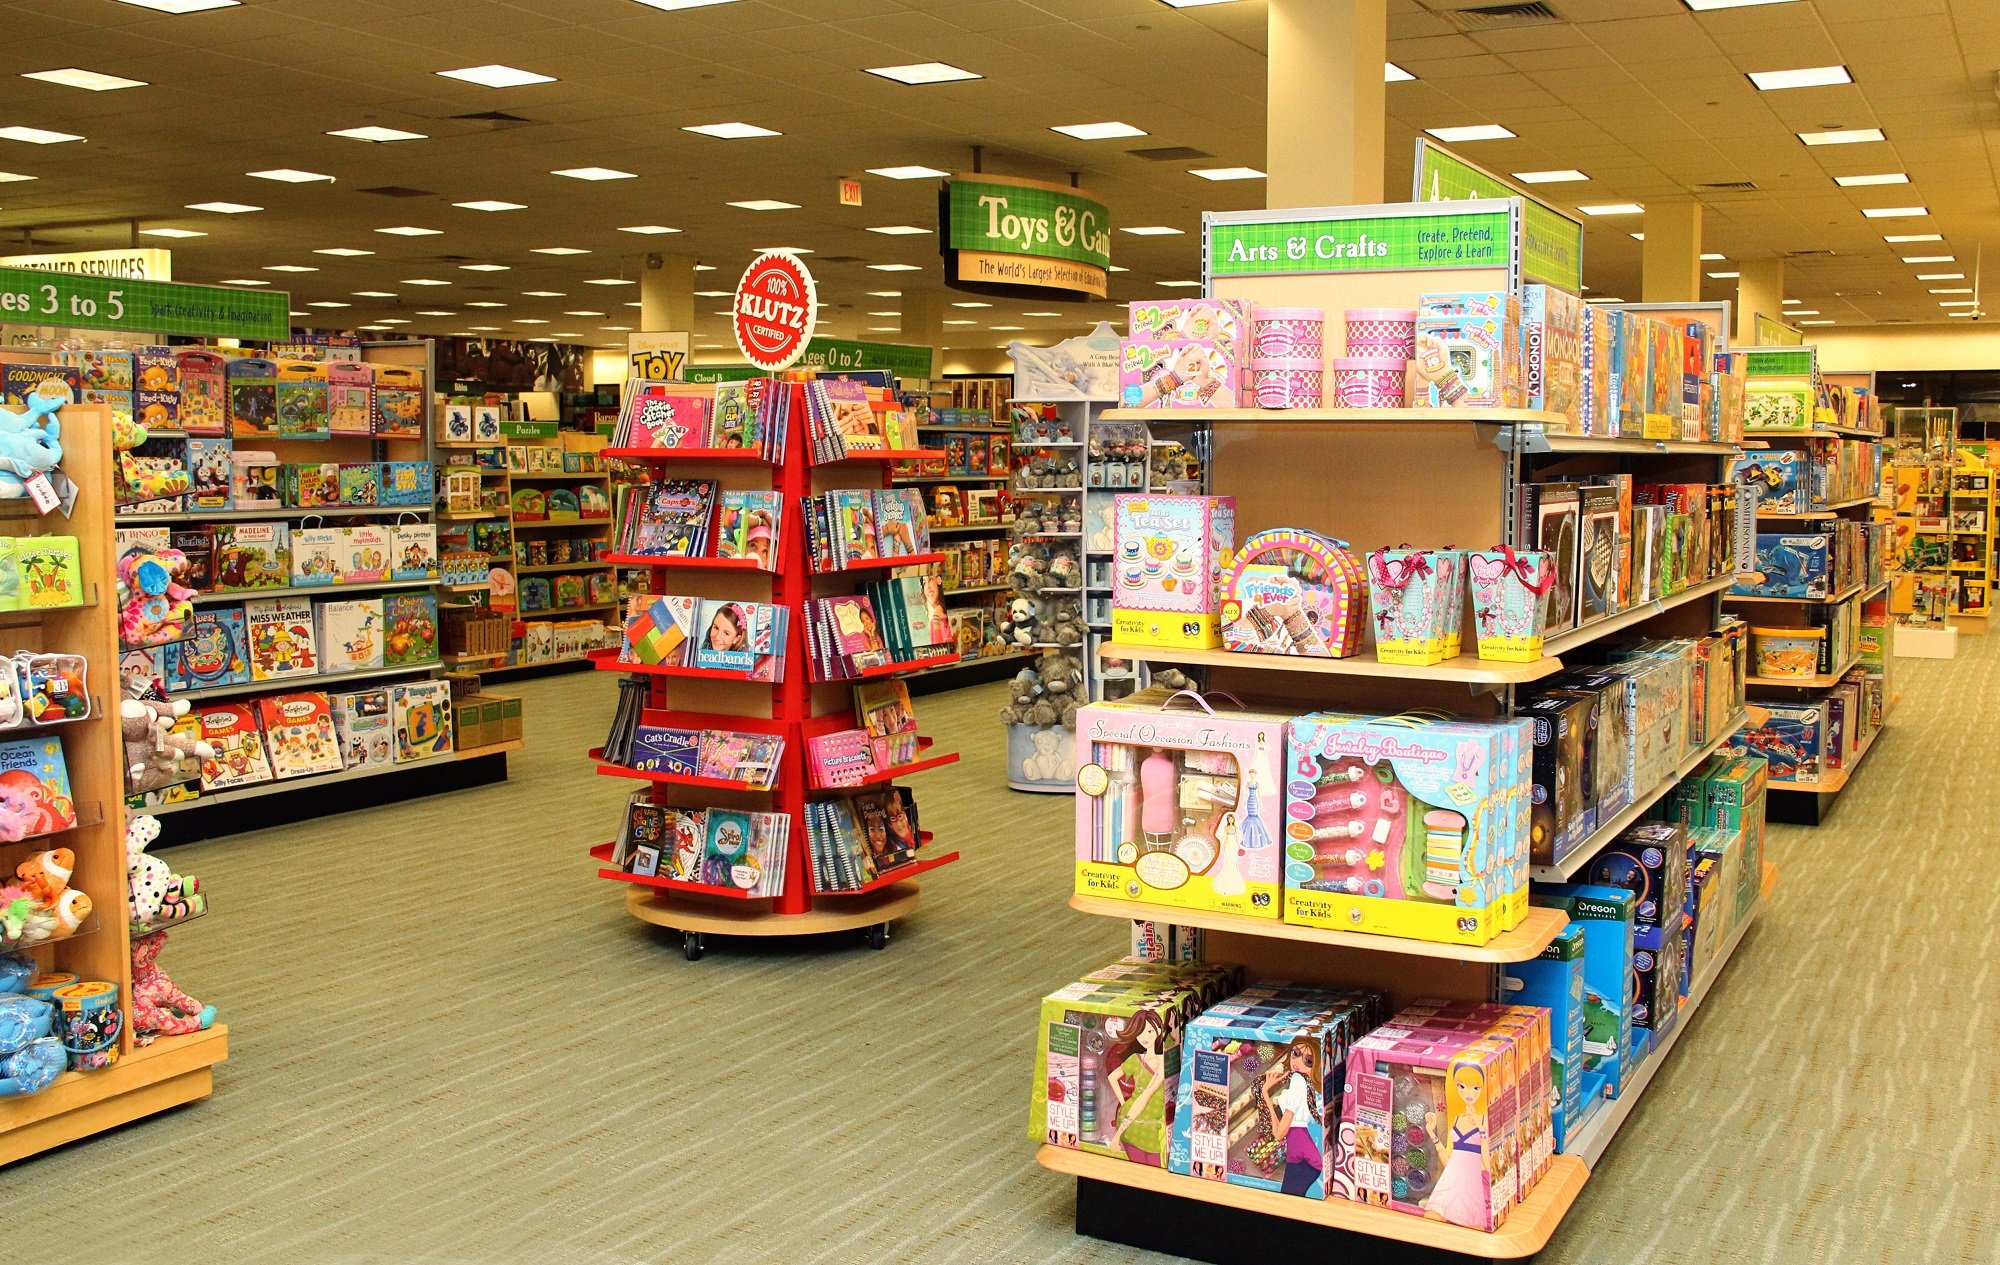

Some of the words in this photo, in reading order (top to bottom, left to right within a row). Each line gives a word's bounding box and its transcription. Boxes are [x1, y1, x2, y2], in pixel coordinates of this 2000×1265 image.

[844, 182, 859, 203] EXIT
[978, 195, 1049, 250] Toys
[1054, 205, 1076, 247] &
[1417, 228, 1449, 243] Create,
[1452, 227, 1493, 243] Pretend,
[1227, 238, 1279, 262] Arts
[1286, 236, 1307, 260] &
[1314, 233, 1389, 259] Crafts
[1418, 245, 1451, 262] Explore
[1455, 245, 1463, 259] &
[1466, 244, 1492, 258] Learn
[979, 258, 994, 275] The
[997, 261, 1026, 279] World's
[1028, 263, 1053, 283] Largest
[766, 277, 788, 297] 100%
[0, 291, 31, 312] es
[40, 284, 60, 314] 3
[70, 294, 97, 317] to
[107, 290, 124, 320] 5
[175, 302, 216, 322] Creativity
[227, 306, 272, 327] Imagination
[740, 292, 804, 329] KLUTZ
[753, 324, 784, 341] CERTIFIED
[139, 356, 157, 366] Feed
[828, 347, 837, 366] 0
[840, 352, 851, 367] to
[854, 349, 863, 368] 2
[1528, 321, 1541, 397] MONOPOLY
[694, 373, 715, 383] Cloud
[717, 373, 723, 382] B
[139, 392, 157, 403] Feed
[642, 401, 672, 415] Cootie
[595, 411, 621, 424] Bargai
[640, 409, 676, 424] Catcher
[516, 424, 541, 434] Puzzles
[1131, 515, 1161, 529] Tea
[1162, 515, 1191, 531] Set
[129, 529, 159, 539] BINGO
[238, 527, 271, 535] MADELINE
[358, 530, 373, 538] little
[397, 532, 413, 541] pesky
[413, 531, 432, 540] pirates
[352, 536, 382, 545] mermaids
[1245, 582, 1296, 599] Friends
[1262, 591, 1290, 605] Ever
[328, 603, 354, 613] Balance
[250, 613, 271, 624] MISS
[271, 610, 312, 622] WEATHER
[1115, 618, 1145, 627] Creativity
[1120, 625, 1129, 633] for
[1129, 625, 1145, 634] Kids
[1380, 647, 1405, 655] Creativity
[1405, 647, 1413, 655] for
[1481, 644, 1506, 652] Creativity
[1506, 644, 1514, 652] for
[698, 650, 754, 665] headbands
[286, 715, 312, 724] GAMES
[208, 726, 235, 736] GAMES
[1089, 719, 1136, 739] Special
[1138, 724, 1194, 745] Occasion
[1197, 728, 1252, 750] Fashions
[644, 732, 663, 744] Cat's
[663, 732, 690, 748] Cradle
[0, 750, 36, 761] Ocean
[1324, 732, 1380, 764] Jewelry
[1377, 737, 1448, 764] Boutique
[0, 758, 38, 771] Friends
[823, 755, 843, 767] Picture
[843, 751, 867, 763] Bracelets
[290, 767, 315, 776] Dress-Up
[213, 780, 227, 788] Silly
[227, 777, 244, 785] Faces
[718, 826, 743, 845] Spiral
[1081, 868, 1121, 881] Creativity
[1087, 878, 1100, 887] for
[1100, 879, 1120, 890] Kids
[1220, 901, 1243, 909] WARNING
[1288, 896, 1333, 911] Creativity
[1296, 907, 1310, 917] for
[1310, 907, 1332, 919] Kids
[1049, 1103, 1075, 1120] STYLE
[1050, 1116, 1062, 1128] ME
[1062, 1118, 1076, 1132] UP!
[1193, 1135, 1223, 1150] STYLE
[1194, 1146, 1209, 1160] ME
[1209, 1148, 1224, 1163] UP!
[1357, 1160, 1387, 1178] STYLE
[1357, 1172, 1372, 1187] ME
[1372, 1176, 1388, 1191] UP!
